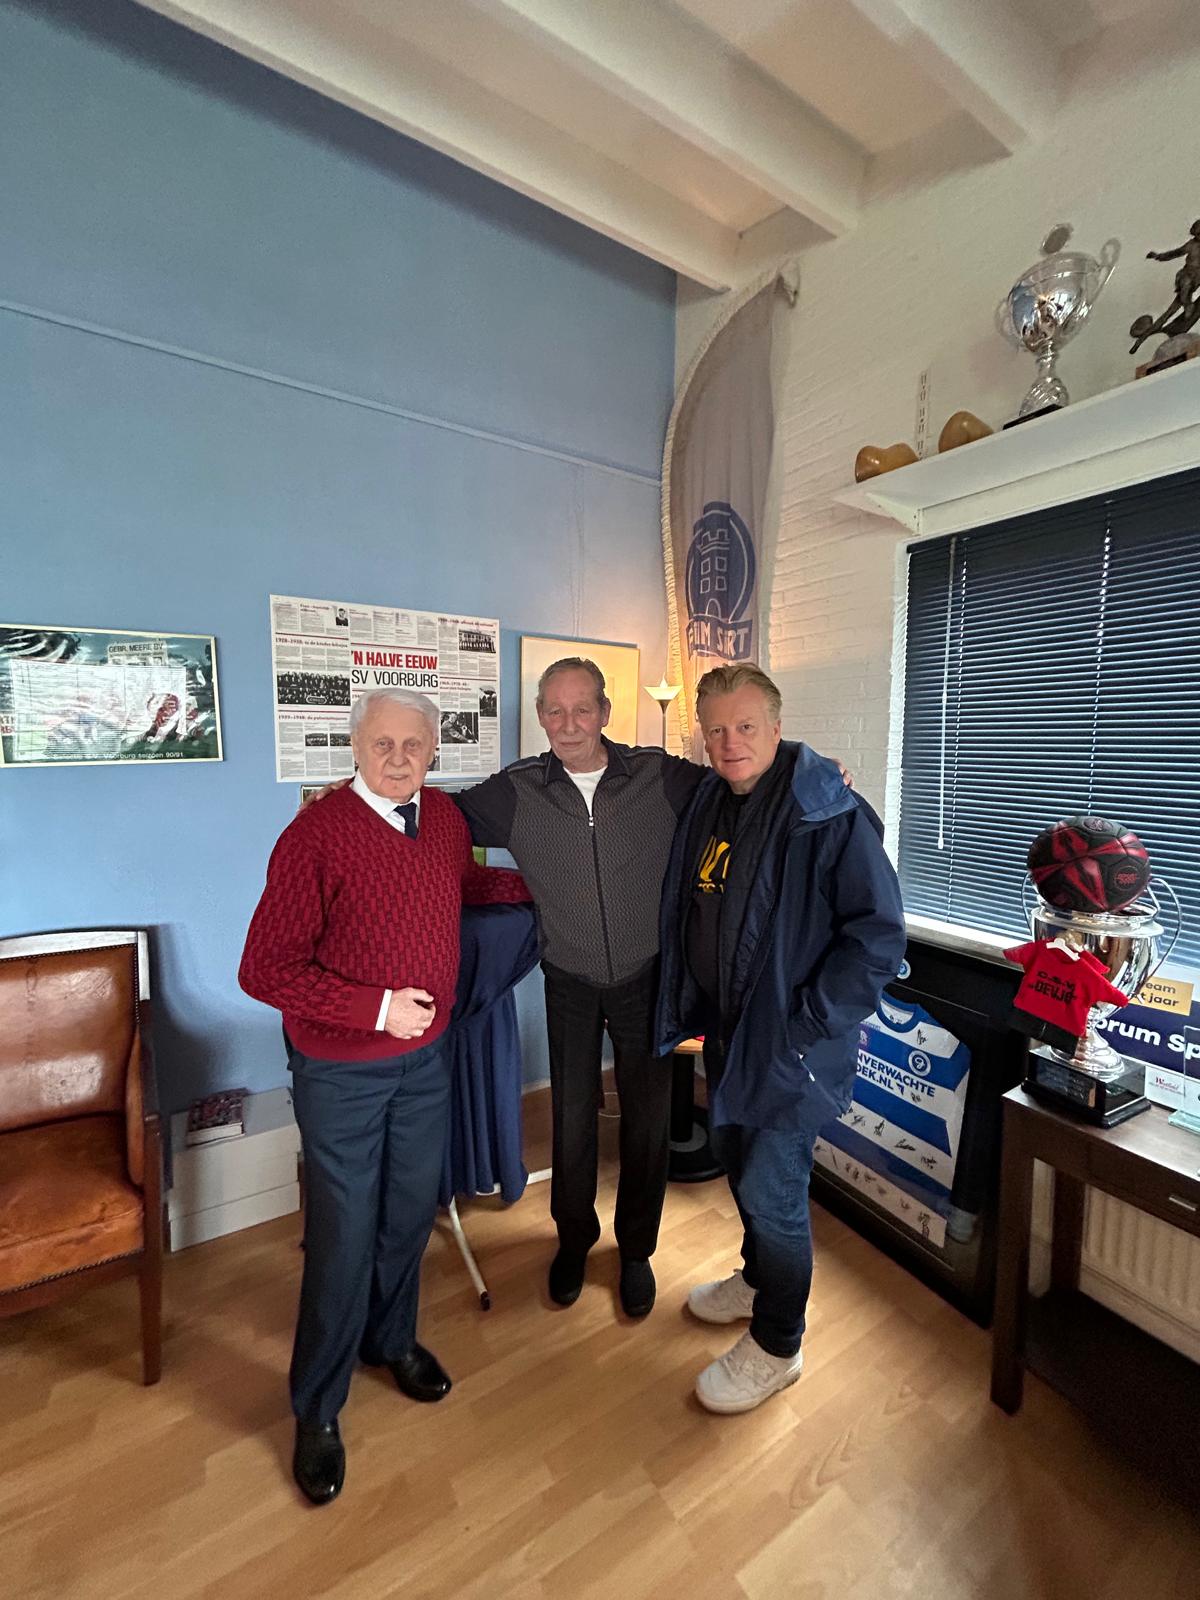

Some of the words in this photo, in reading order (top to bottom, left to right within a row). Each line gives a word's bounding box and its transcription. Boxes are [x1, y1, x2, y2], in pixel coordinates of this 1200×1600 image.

[351, 650, 363, 666] 'N
[366, 651, 403, 668] HALVE
[405, 654, 438, 670] EEUW
[351, 669, 368, 684] SV
[373, 670, 438, 688] VOORBURG
[1148, 992, 1180, 1007] jaar
